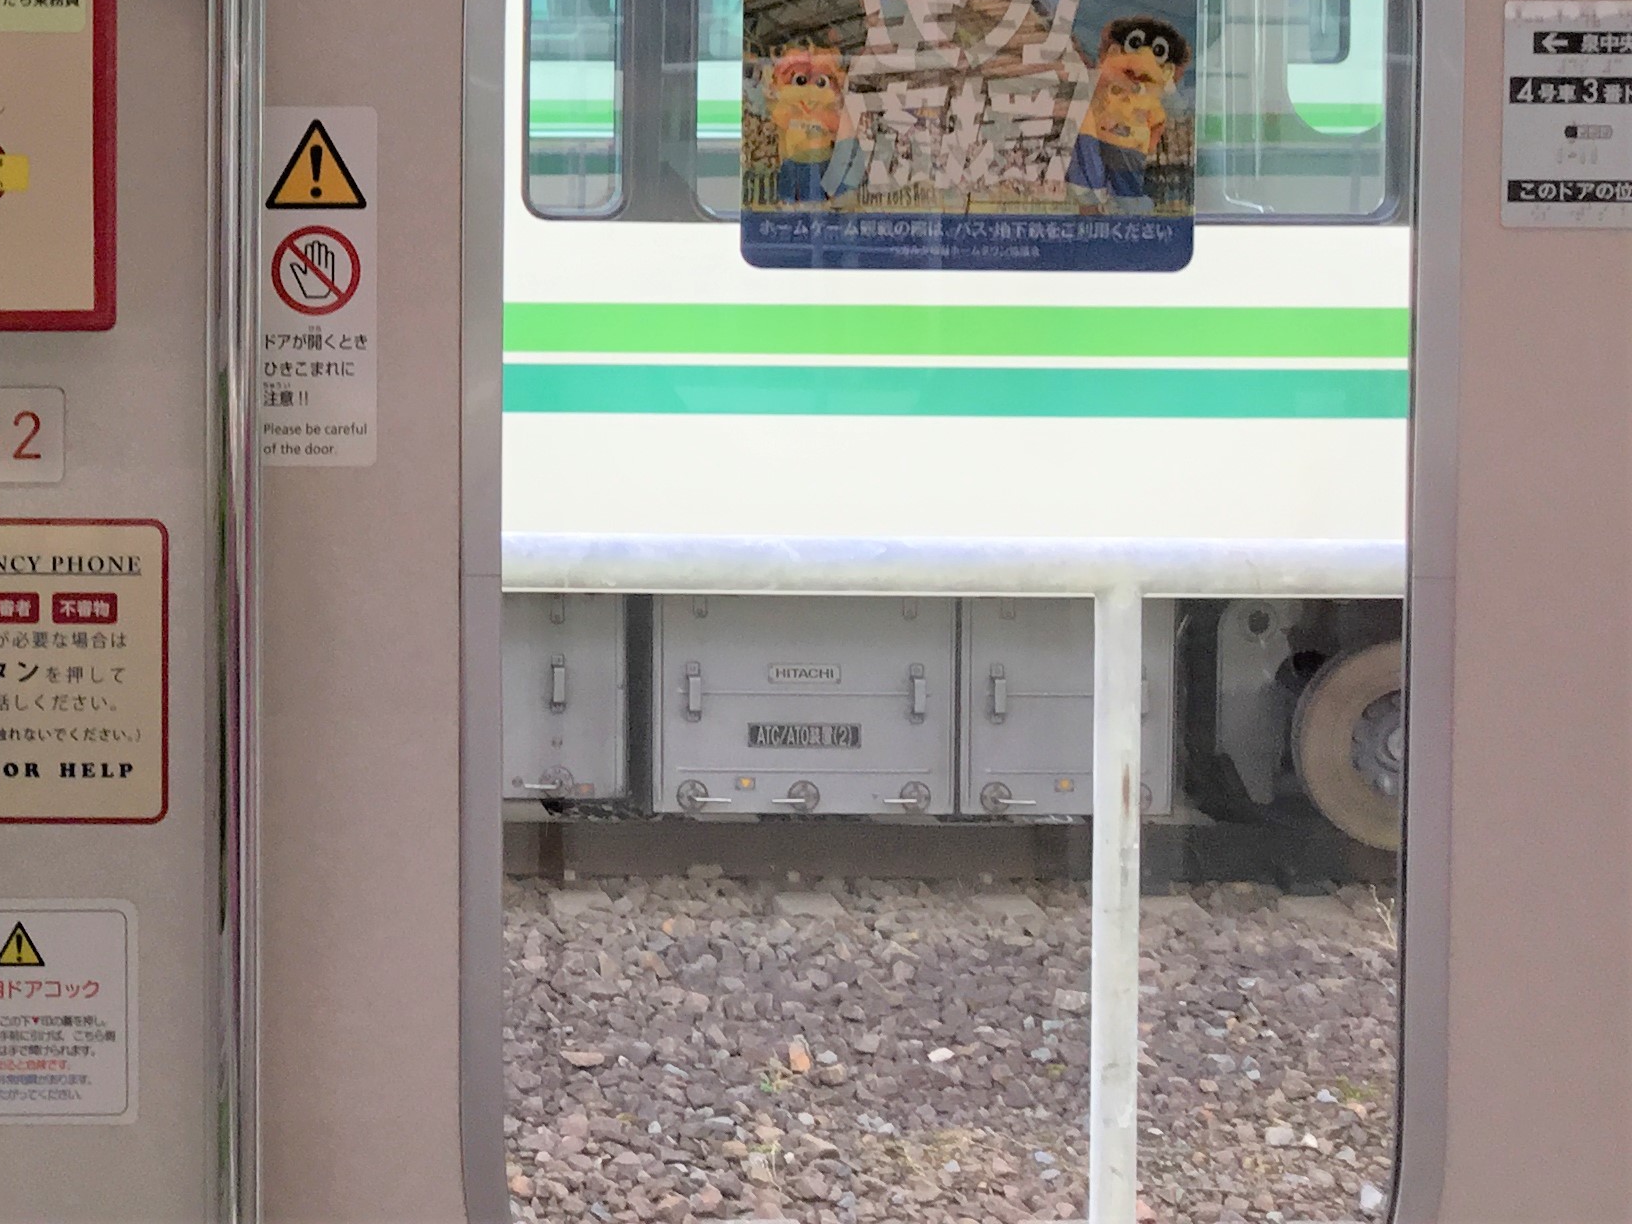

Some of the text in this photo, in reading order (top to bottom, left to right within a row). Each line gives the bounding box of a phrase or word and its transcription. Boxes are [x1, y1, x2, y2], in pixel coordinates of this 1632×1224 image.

[265, 334, 368, 350] ドアが開くとき
[264, 362, 354, 377] ひきこまれに
[263, 422, 367, 435] Please be careful
[263, 443, 276, 455] of
[281, 443, 301, 455] the
[52, 555, 142, 573] PHONE
[59, 599, 110, 617] 不審物
[775, 668, 834, 679] HITACHI
[60, 762, 134, 778] HELP
